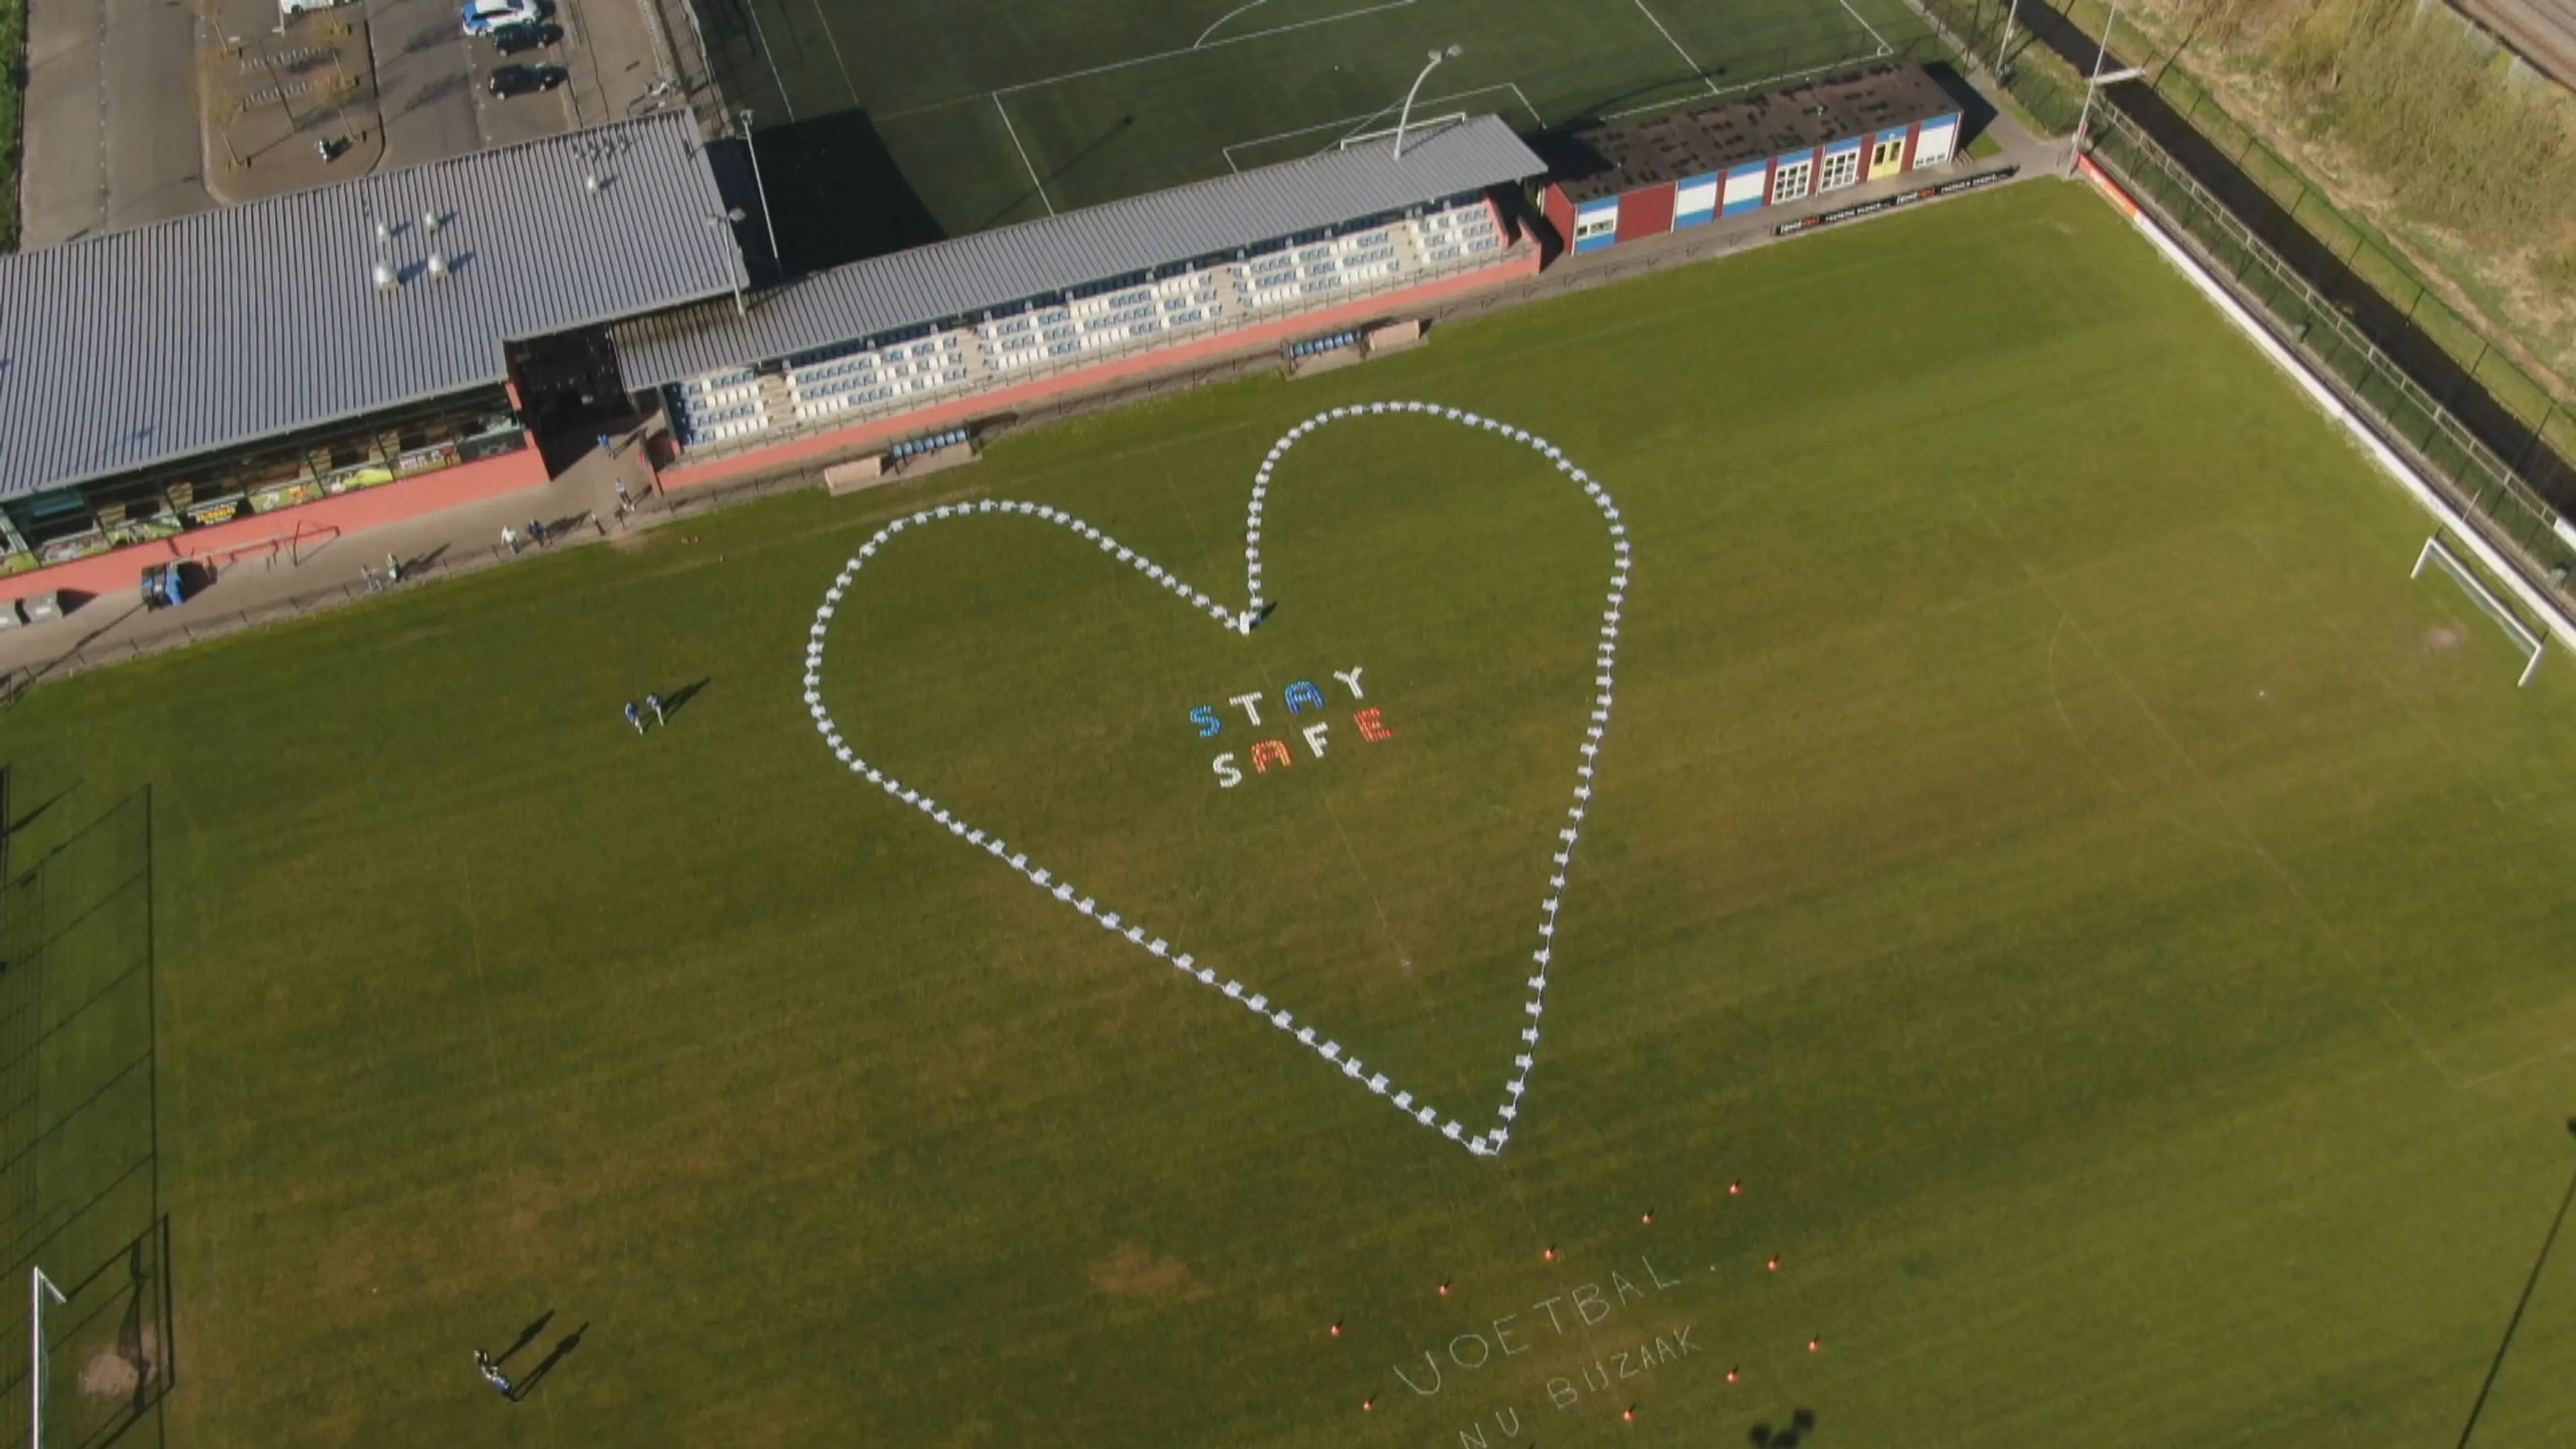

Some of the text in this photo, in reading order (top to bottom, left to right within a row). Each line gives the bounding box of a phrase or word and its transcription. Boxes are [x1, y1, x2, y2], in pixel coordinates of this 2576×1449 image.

[1189, 665, 1364, 737] STAY
[1213, 706, 1394, 788] SAFE
[1459, 1325, 1703, 1449] NU BIJZAAK
